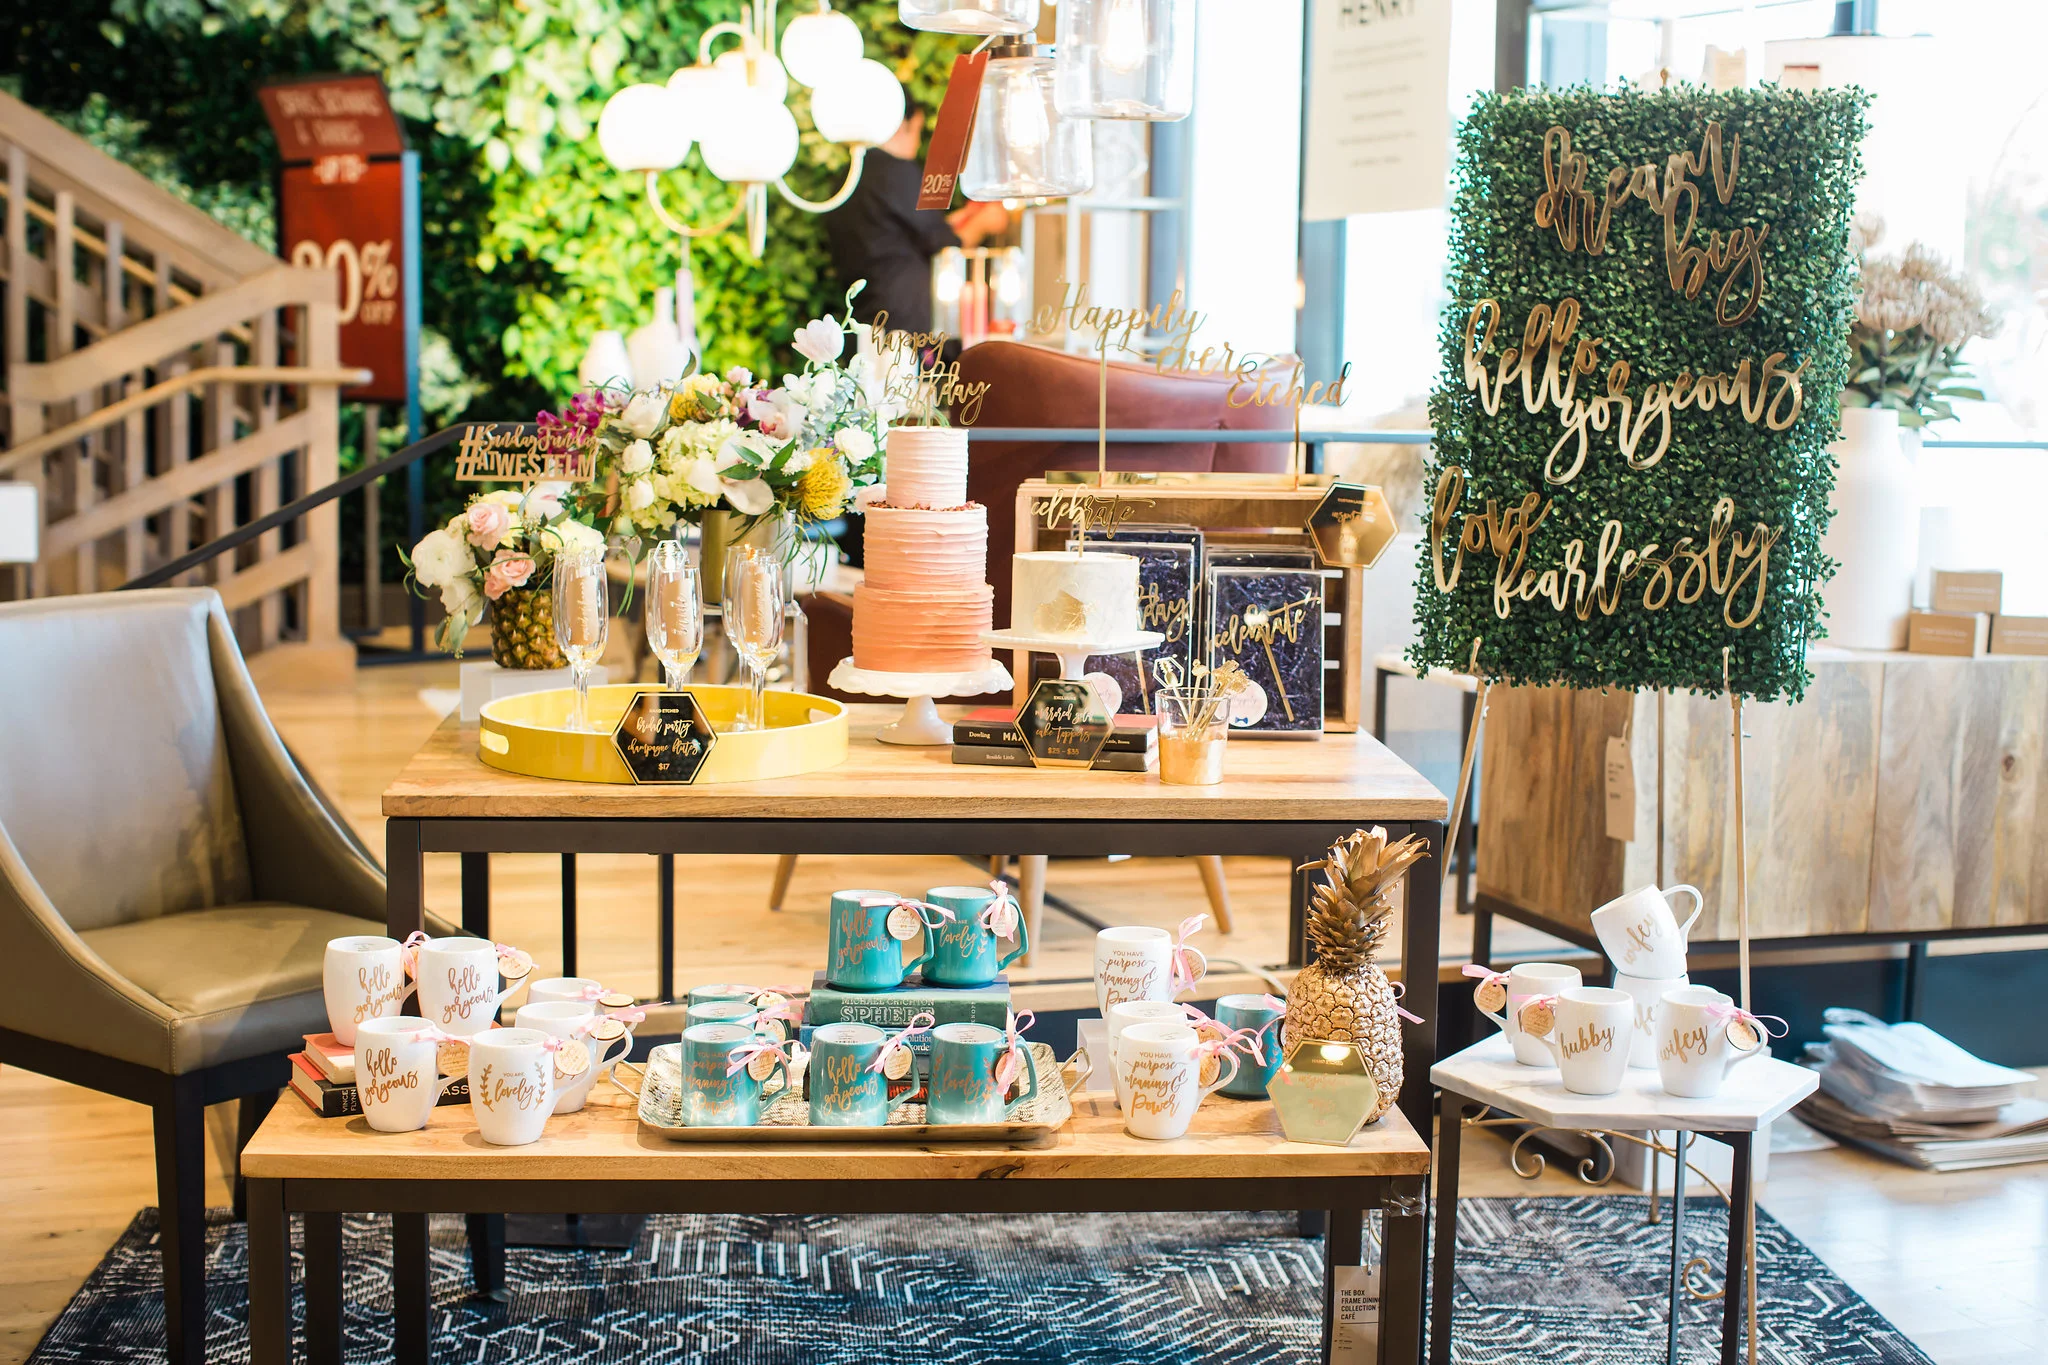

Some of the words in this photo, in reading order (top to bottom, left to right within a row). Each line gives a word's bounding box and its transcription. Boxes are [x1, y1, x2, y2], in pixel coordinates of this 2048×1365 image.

[1535, 121, 1740, 256] dream
[1664, 182, 1769, 327] big
[1028, 283, 1207, 351] Happily
[871, 310, 951, 372] happy
[1465, 297, 1602, 416] hello
[884, 361, 992, 426] birthday
[1226, 352, 1352, 408] Etched
[1545, 352, 1811, 485] gorgeous
[1031, 483, 1156, 539] celebrate
[1432, 466, 1552, 593] love
[1494, 497, 1783, 628] fearlessly
[664, 720, 694, 738] party
[969, 731, 991, 739] Dowling
[627, 738, 669, 757] champagne
[1047, 746, 1060, 754] $25
[658, 762, 671, 771] $17
[841, 908, 872, 938] hello
[1624, 912, 1663, 965] wifey
[836, 934, 890, 968] gorgeous
[940, 925, 980, 958] lovely
[359, 963, 391, 994] hello
[448, 964, 480, 995] hello
[1103, 958, 1150, 973] purpose
[354, 984, 402, 1024] gorgeous
[443, 986, 494, 1024] gorgeous
[840, 1006, 935, 1024] SPHERE
[841, 997, 885, 1005] MICHAEL
[886, 997, 934, 1005] CRICHTON
[1560, 1022, 1615, 1060] hubby
[1660, 1025, 1708, 1063] wifey
[366, 1047, 397, 1079] hello
[828, 1054, 861, 1085] hello
[1128, 1060, 1181, 1076] purpose
[365, 1070, 418, 1107] gorgeous
[494, 1078, 537, 1111] lovely
[823, 1075, 878, 1116] gorgeous
[942, 1069, 983, 1104] lovely
[1131, 1091, 1180, 1118] Power
[1341, 1312, 1355, 1320] CAFÉ
